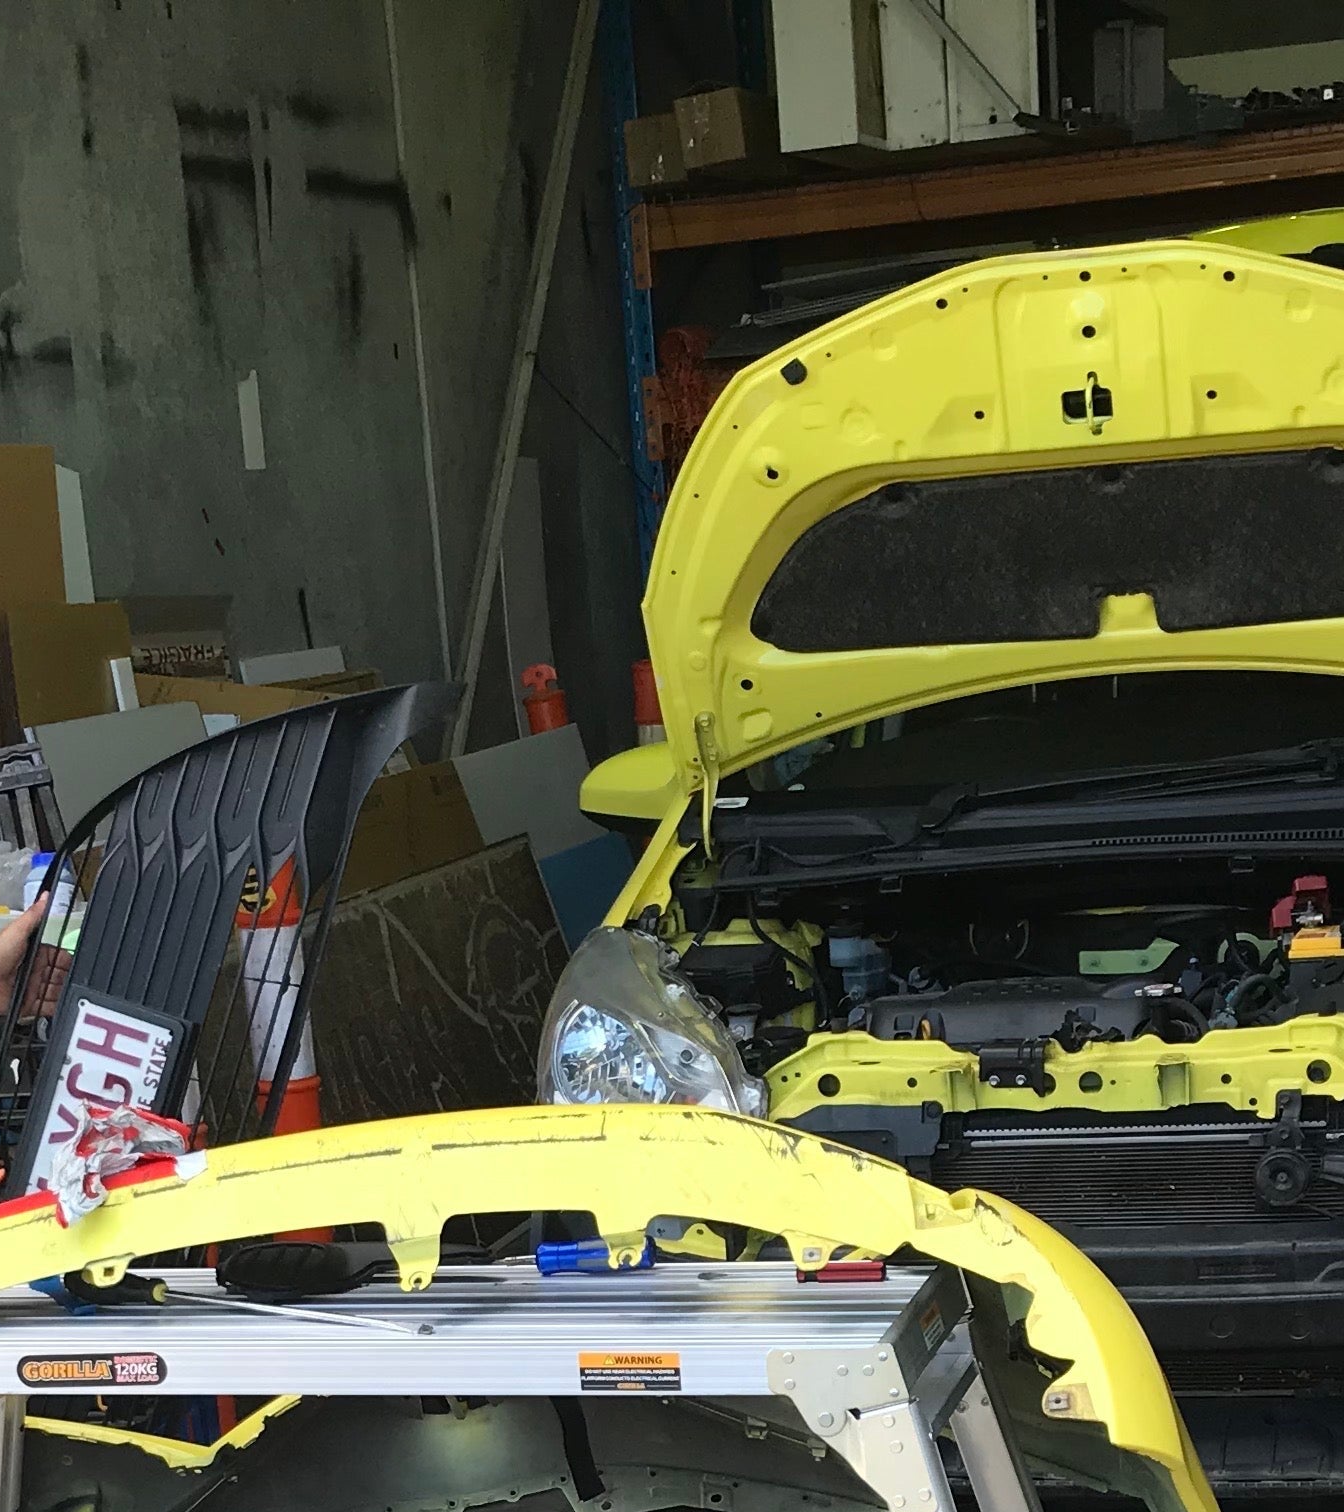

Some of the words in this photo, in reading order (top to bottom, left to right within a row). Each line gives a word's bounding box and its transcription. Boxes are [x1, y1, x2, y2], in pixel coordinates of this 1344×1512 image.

[615, 1356, 663, 1365] WARNING
[22, 1360, 112, 1382] GORILLA
[115, 1363, 158, 1375] 120KG
[116, 1374, 136, 1382] MAX
[137, 1374, 160, 1382] LOAD
